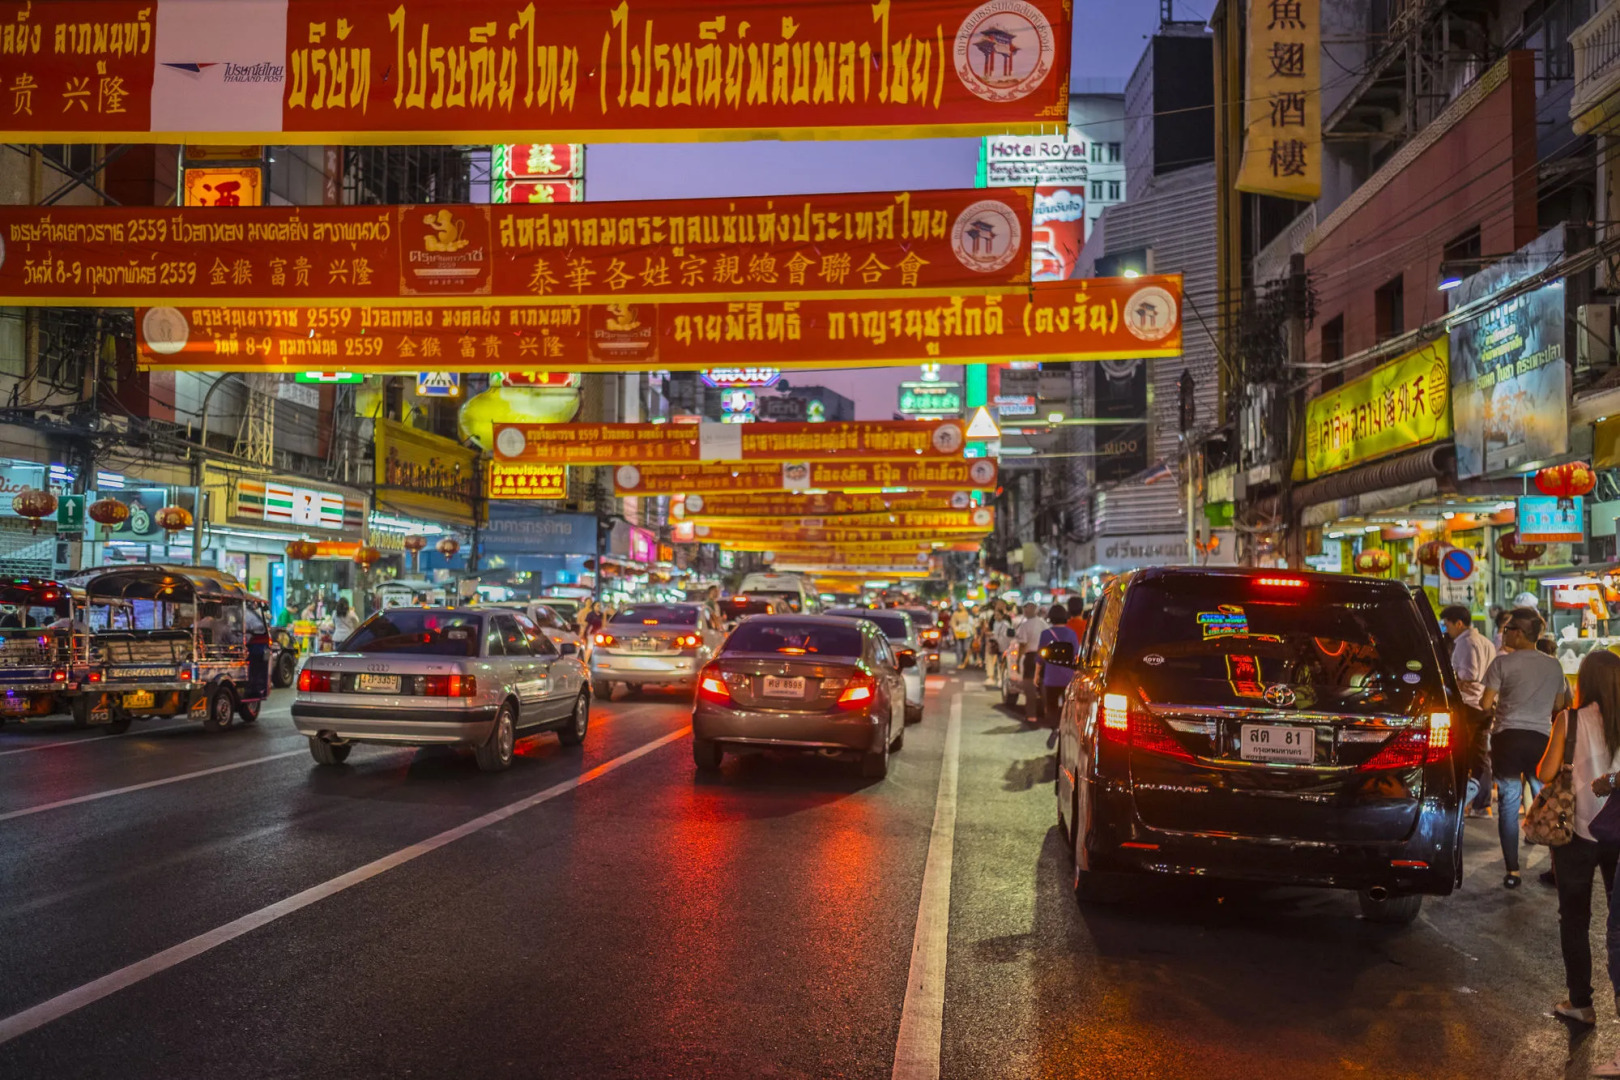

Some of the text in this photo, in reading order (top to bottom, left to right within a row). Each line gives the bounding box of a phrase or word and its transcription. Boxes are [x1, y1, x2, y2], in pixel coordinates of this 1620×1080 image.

[0, 1, 41, 56] ลยิ่ง
[222, 61, 284, 77] ไปรษณีย์ไทย
[288, 18, 371, 117] บริษัท
[388, 2, 579, 115] ไปรษณีย์ไทย
[223, 74, 285, 83] THAILAND POST
[1266, 0, 1308, 178] 魚翅酒樓
[991, 142, 1086, 161] Hotel Royal
[127, 219, 168, 242] 2559
[56, 260, 81, 284] 8-9
[160, 261, 197, 285] 2559
[208, 255, 374, 287] 金猴 富贵 兴隆
[192, 307, 299, 337] ตรุษจนเยาวราช
[307, 308, 352, 328] 2559
[246, 336, 272, 354] 8-9
[345, 336, 383, 356] 2559
[396, 335, 565, 358] 金猴 富贵 兴隆
[1104, 440, 1138, 454] MIDO
[1250, 728, 1301, 745] สต 81
[1253, 746, 1302, 756] กรุงเทพมหานคร
